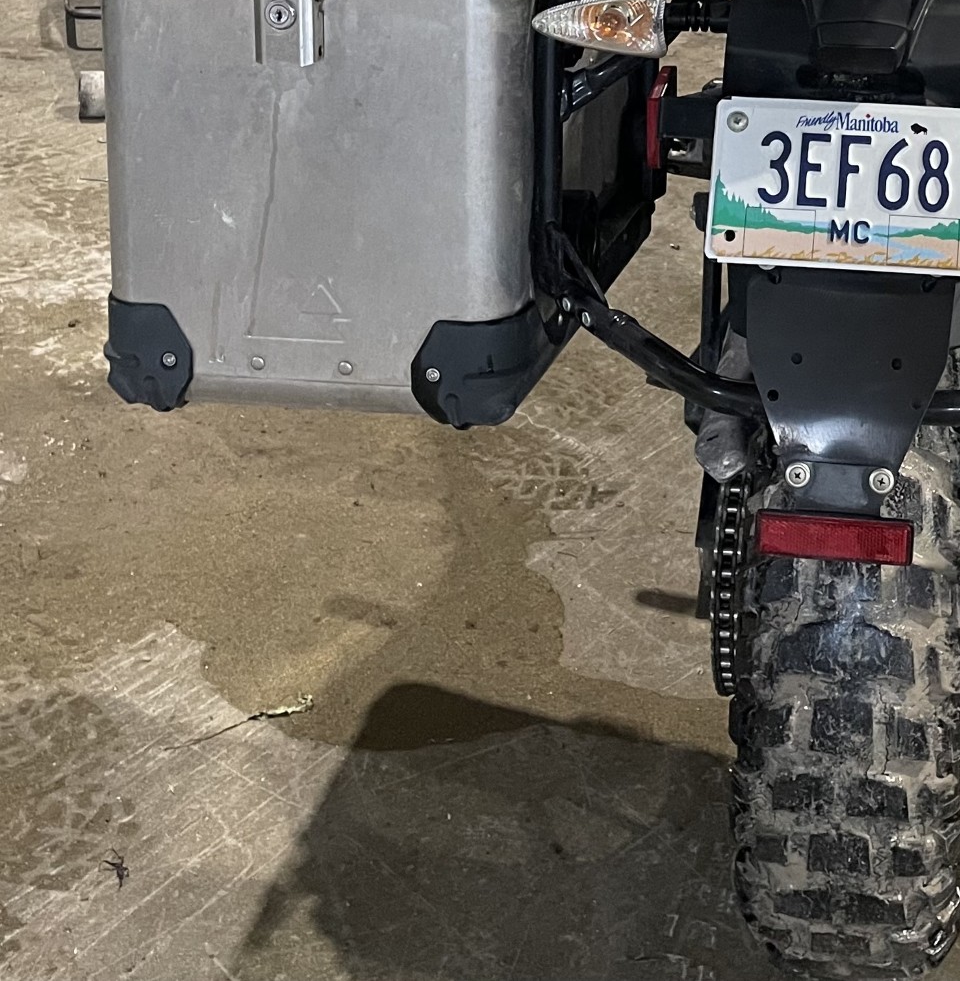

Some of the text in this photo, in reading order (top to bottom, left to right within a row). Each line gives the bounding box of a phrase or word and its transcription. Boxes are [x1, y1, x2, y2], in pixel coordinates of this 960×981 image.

[796, 111, 899, 134] Friendly Manitoba
[757, 130, 950, 213] 3EF68
[830, 219, 871, 245] MC
